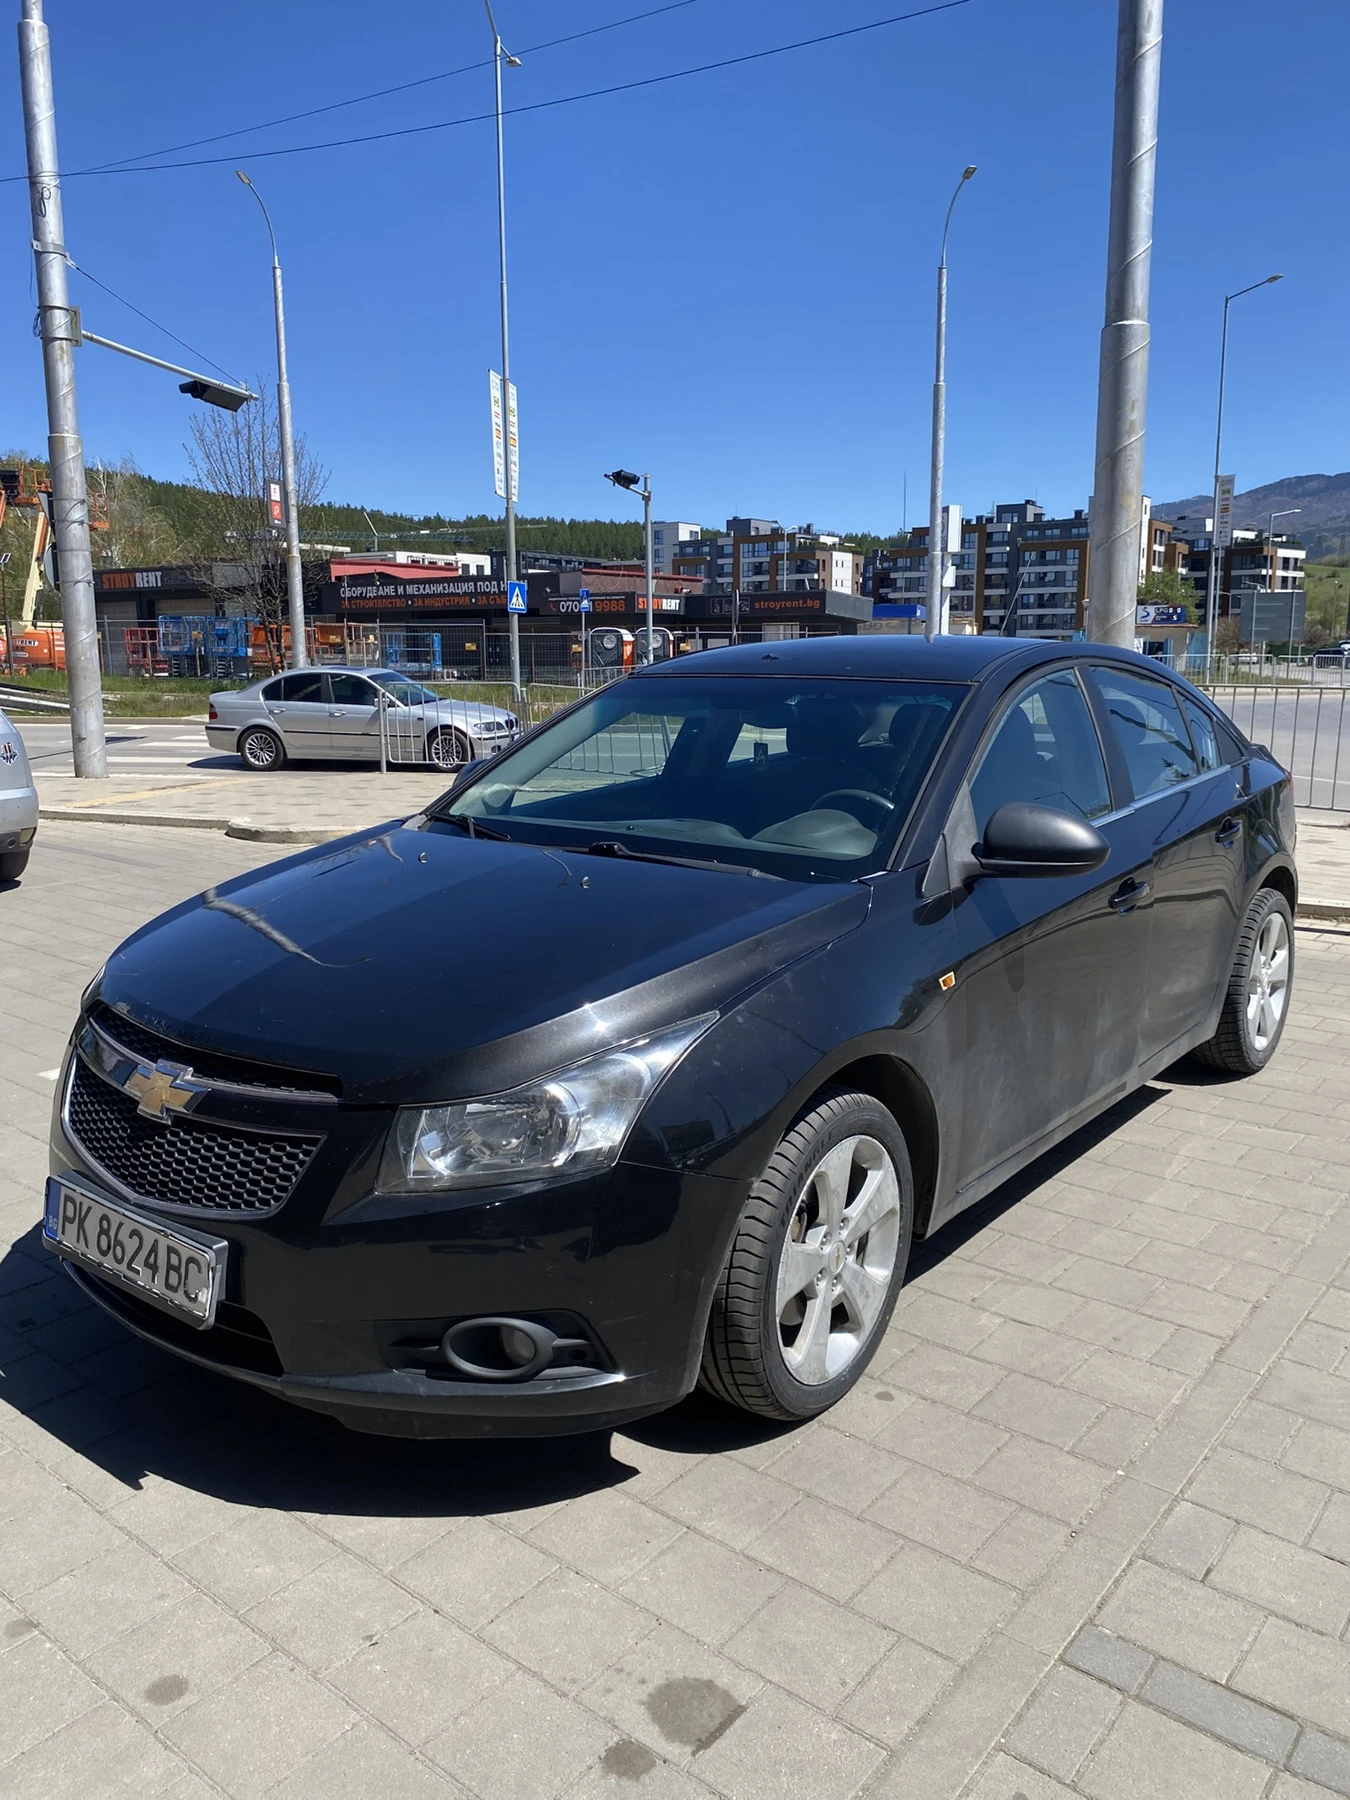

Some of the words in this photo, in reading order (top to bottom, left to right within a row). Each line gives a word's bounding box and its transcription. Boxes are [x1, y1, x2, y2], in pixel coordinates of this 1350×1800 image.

[102, 571, 161, 588] STROYRENT
[397, 585, 404, 595] И
[406, 582, 475, 596] МЕХАНИЗАЦИЯ
[477, 581, 498, 593] ПОД
[425, 597, 470, 607] ИНДУСТРИЯ
[477, 596, 488, 605] ЗА
[595, 600, 626, 612] 9988
[638, 597, 680, 610] STOYRENT
[754, 599, 820, 610] stroyrent.bg
[49, 1215, 58, 1230] BG
